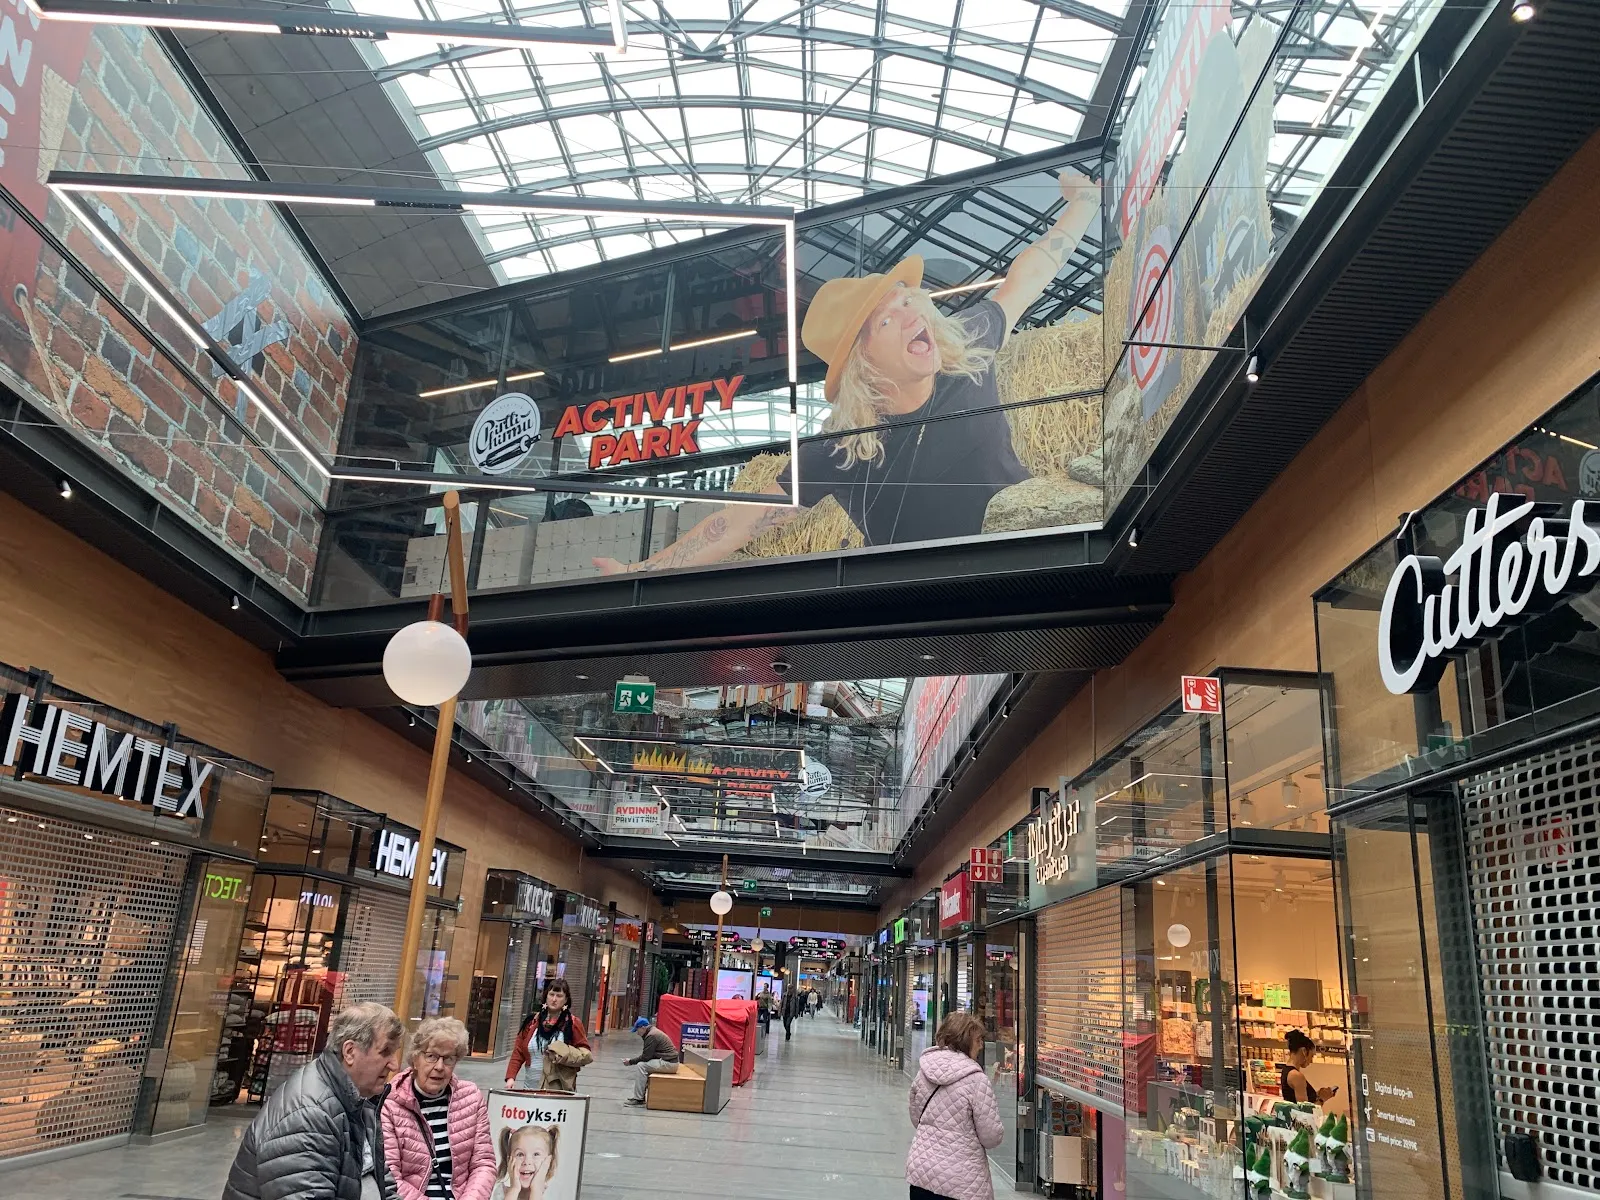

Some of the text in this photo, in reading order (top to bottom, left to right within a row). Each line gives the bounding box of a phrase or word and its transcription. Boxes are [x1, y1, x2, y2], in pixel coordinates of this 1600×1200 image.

[552, 374, 745, 439] ACTIVITY
[588, 418, 704, 470] PARK
[1378, 492, 1600, 694] Cutters
[3, 693, 213, 819] HEMTEX
[375, 829, 448, 889] HEMEX
[501, 1105, 567, 1123] fotoyks.fi
[1374, 1081, 1414, 1100] Digital drop-in
